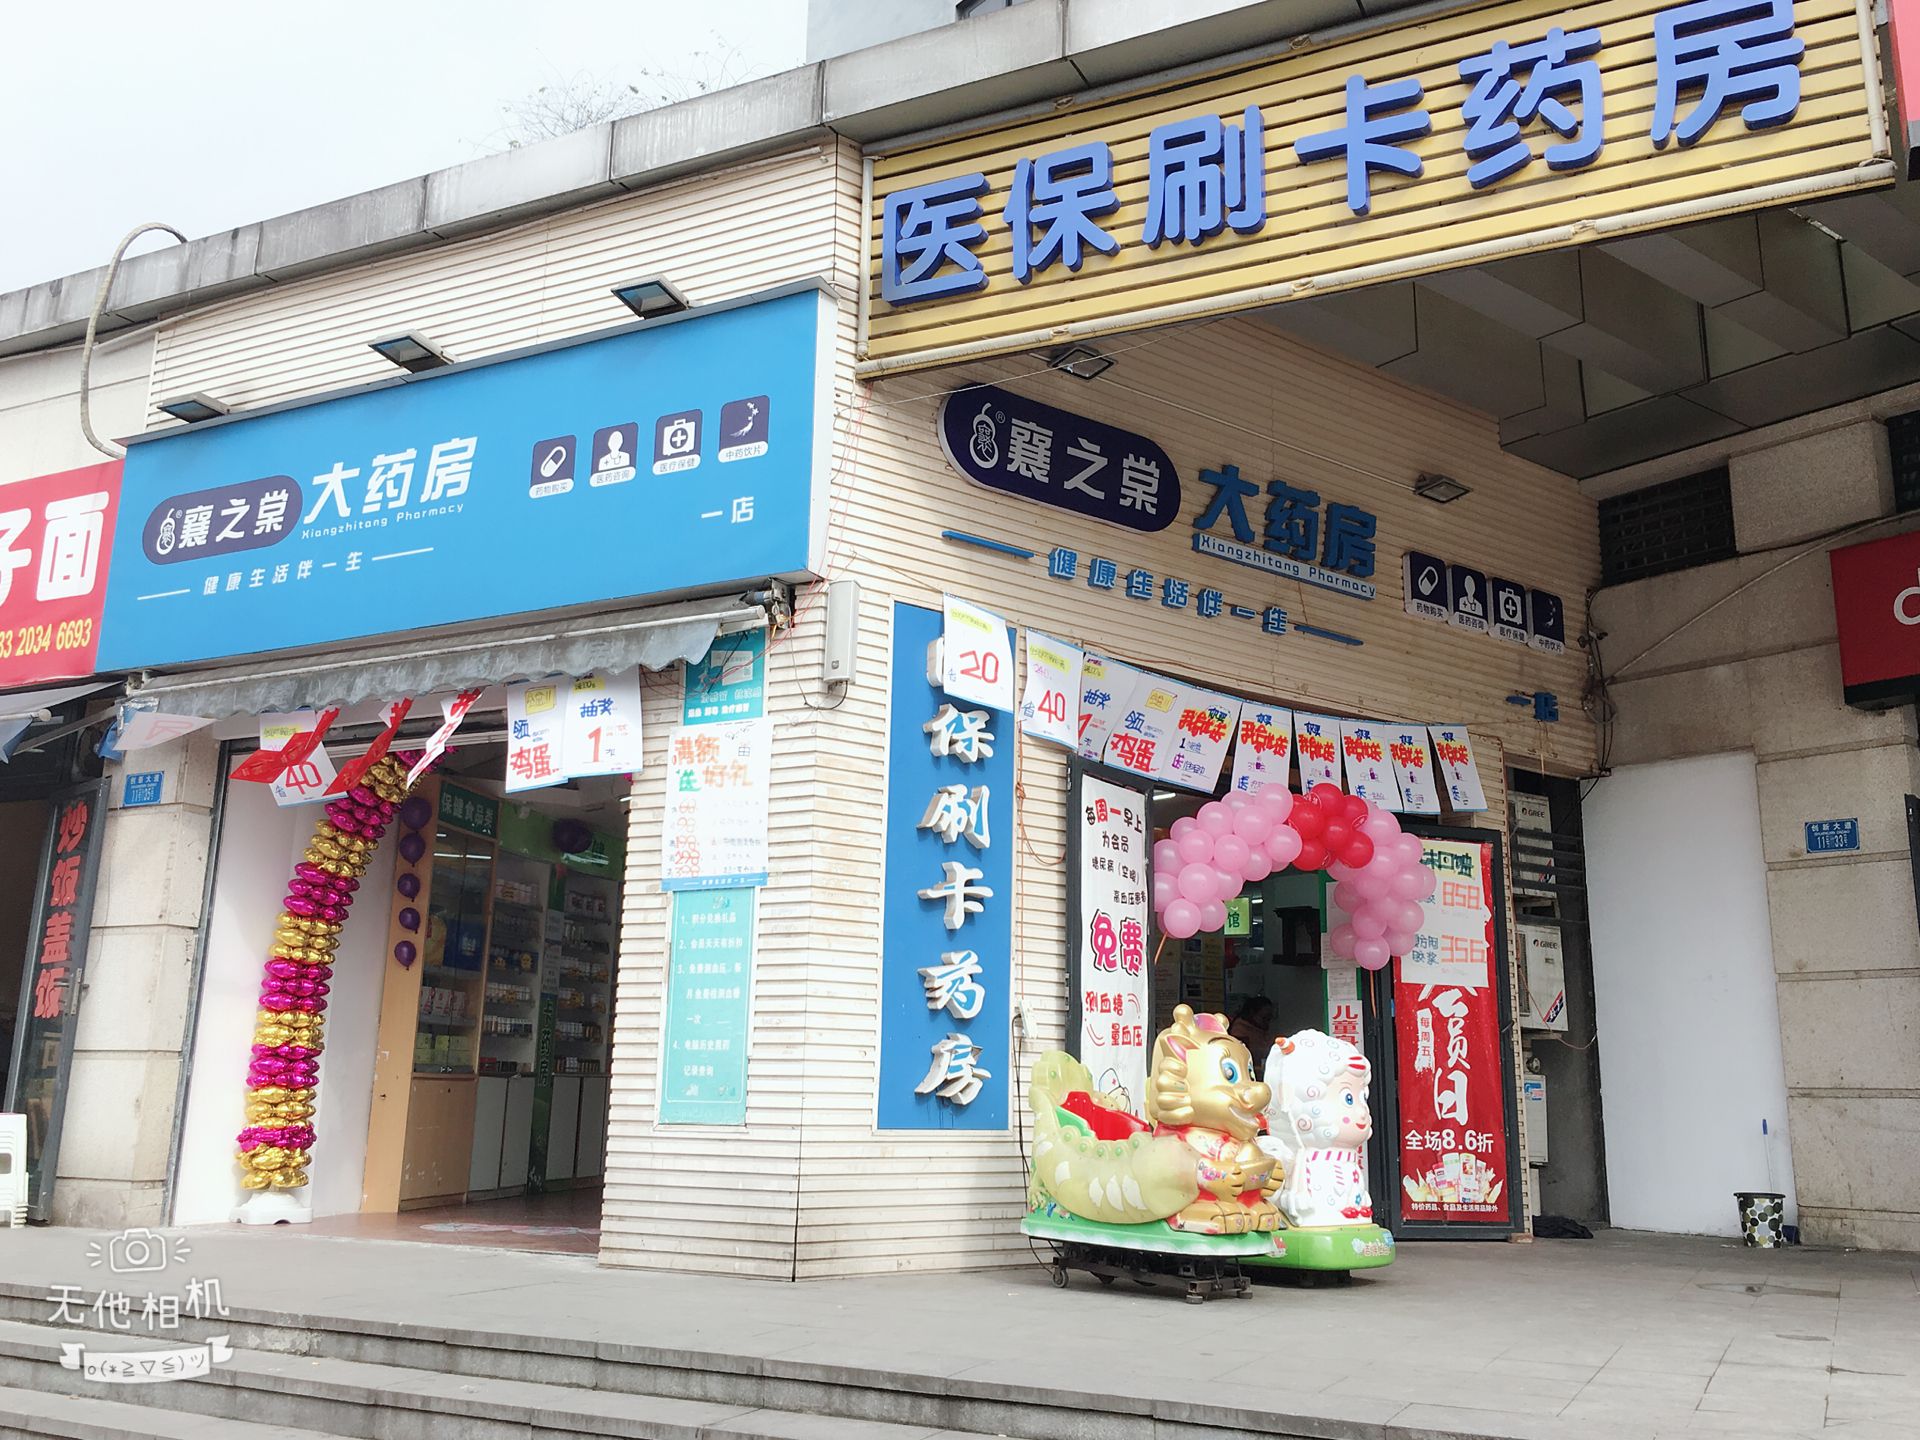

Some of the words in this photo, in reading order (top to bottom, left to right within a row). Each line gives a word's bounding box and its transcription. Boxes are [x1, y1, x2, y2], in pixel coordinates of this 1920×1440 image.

[883, 0, 1804, 306] 医保刷卡药房
[659, 457, 696, 473] 医疗保健
[725, 444, 762, 461] 中药饮片
[304, 437, 478, 523] 大药房
[302, 518, 388, 540] Xiangzhitang
[397, 502, 464, 523] Pharmacy
[701, 496, 754, 524] 一店
[1194, 462, 1377, 579] 大药房
[203, 550, 363, 596] 健康生活伴一生
[1199, 534, 1302, 579] Xiangzhitang
[1308, 563, 1377, 598] Pharmacy
[1048, 546, 1288, 634] 健康生活伴一生
[1416, 602, 1444, 619] 药物购买
[15, 623, 53, 656] 2034
[56, 618, 92, 651] 6693
[1499, 627, 1526, 642] 医疗保健
[1538, 638, 1563, 653] 中药饮片
[960, 650, 999, 684] 20
[580, 698, 614, 718] 抽奖
[1038, 690, 1065, 723] 40
[1083, 689, 1111, 710] 抽奖
[1506, 690, 1559, 722] 一店
[588, 726, 601, 762] 1
[674, 733, 721, 765] 满额
[1110, 732, 1156, 772] 鸡蛋
[510, 743, 551, 779] 鸡蛋
[702, 760, 753, 787] 好礼
[286, 760, 322, 795] 40
[676, 769, 701, 791] 送
[1086, 798, 1142, 834] 每周一早上
[1528, 810, 1545, 818] GREE
[1811, 822, 1852, 832] 创新大道
[1102, 830, 1129, 854] 为会员
[915, 636, 993, 1106] 保刷卡药房
[34, 801, 88, 1018] 炒饭盖饭
[1443, 881, 1480, 910] 858
[1091, 910, 1143, 977] 免费
[1441, 935, 1486, 963] 356
[1540, 940, 1558, 949] GREE
[1086, 991, 1123, 1016] 测血糖
[1111, 1022, 1142, 1047] 量血压
[1419, 1017, 1432, 1057] 每周五
[1405, 1129, 1494, 1153] 全场8.6折
